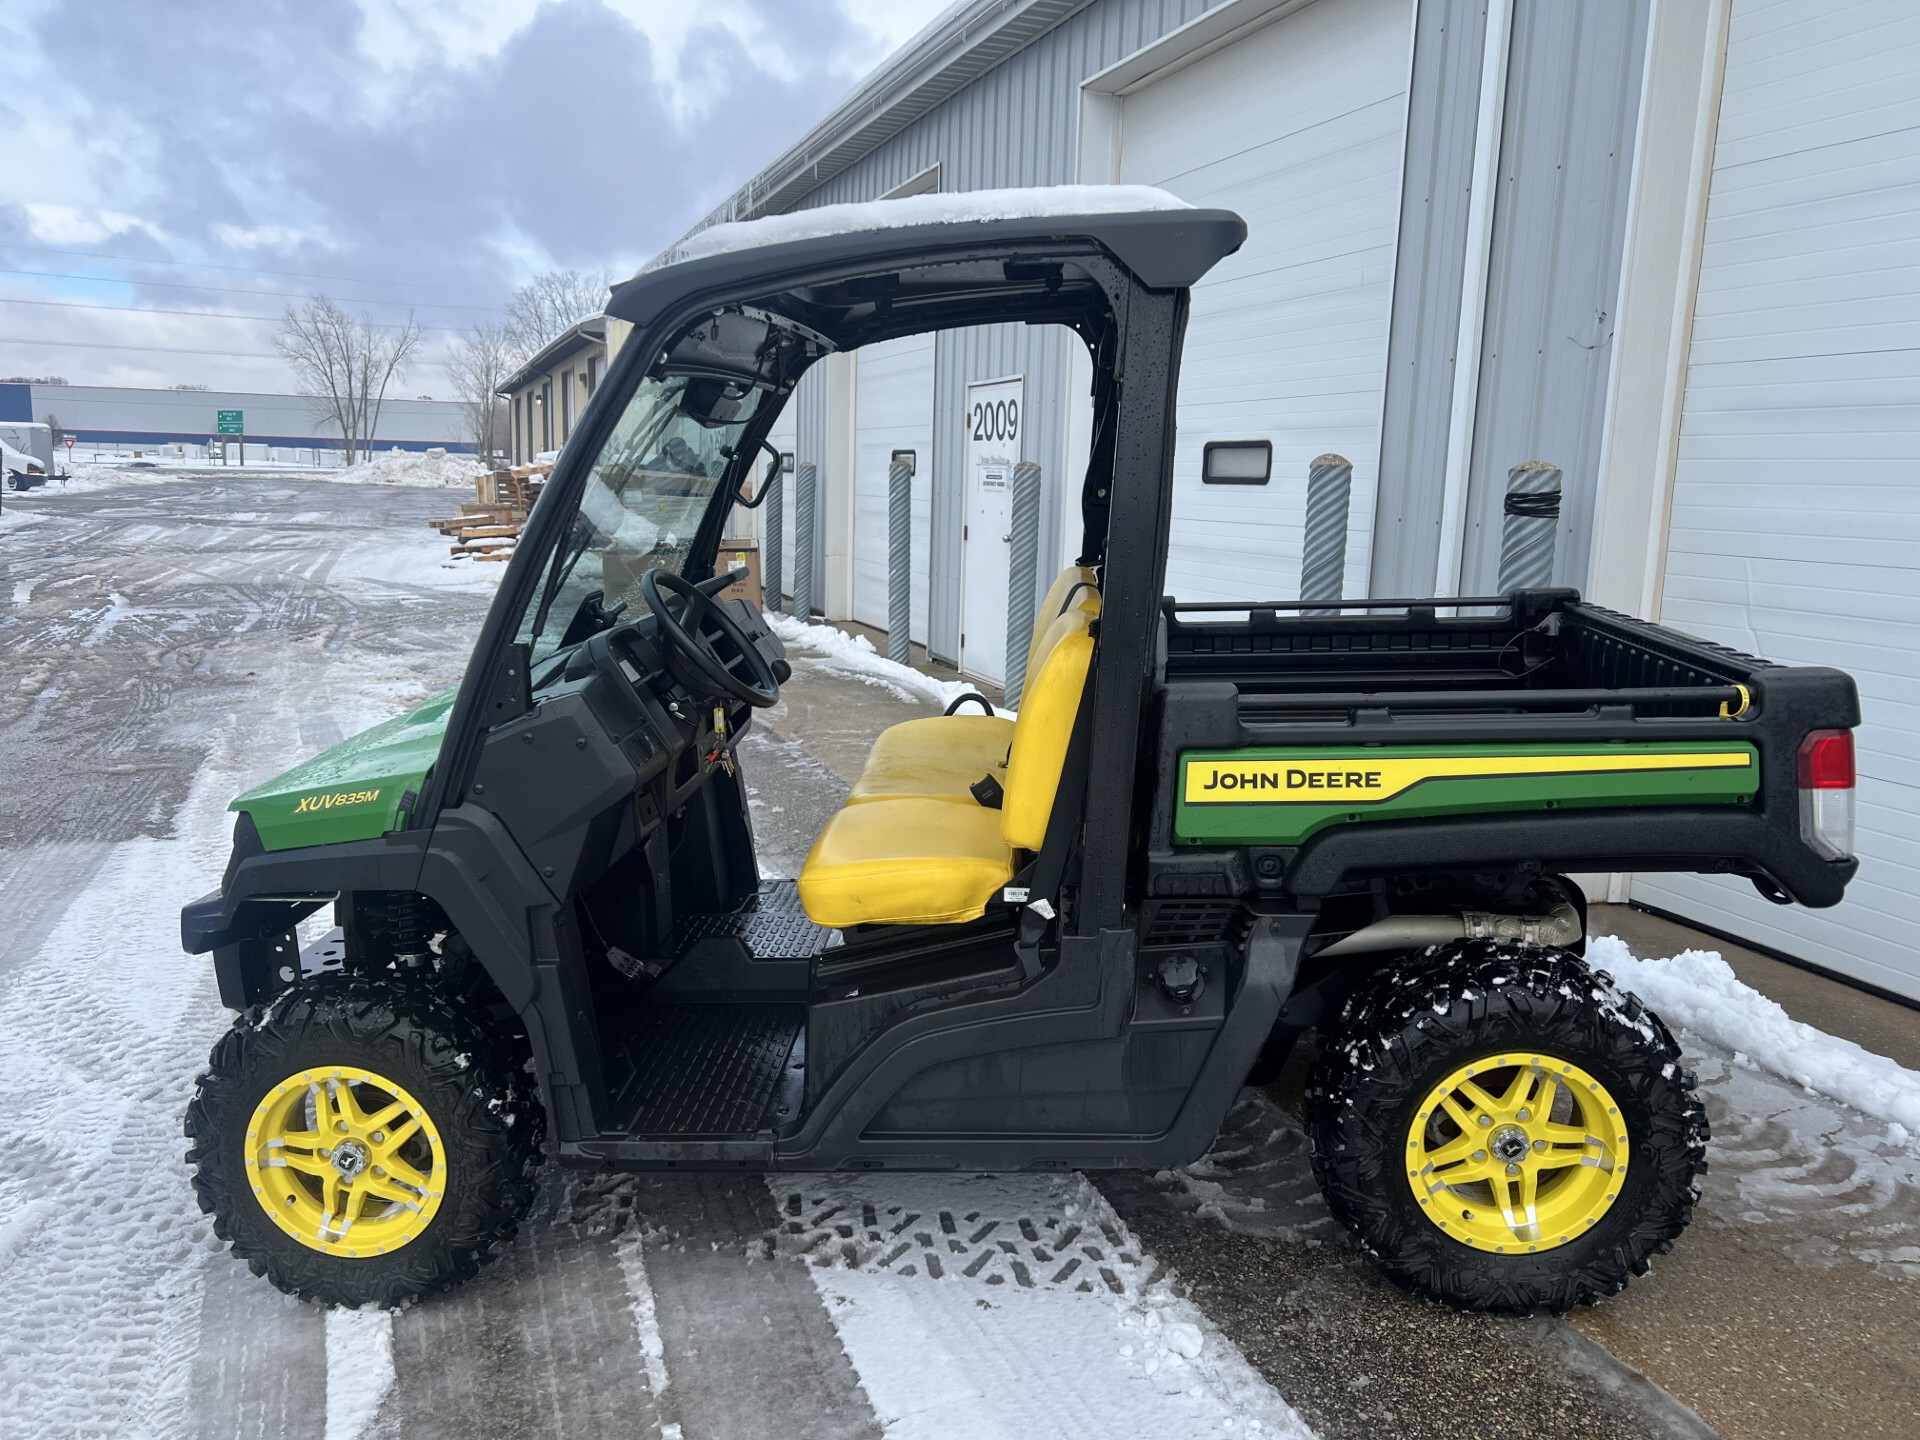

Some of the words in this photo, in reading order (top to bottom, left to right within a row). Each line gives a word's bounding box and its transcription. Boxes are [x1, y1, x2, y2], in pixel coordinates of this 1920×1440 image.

[973, 399, 1018, 441] 2009
[1203, 770, 1279, 790] JOHN
[1286, 769, 1382, 789] DEERE
[294, 789, 380, 814] XUV835M
